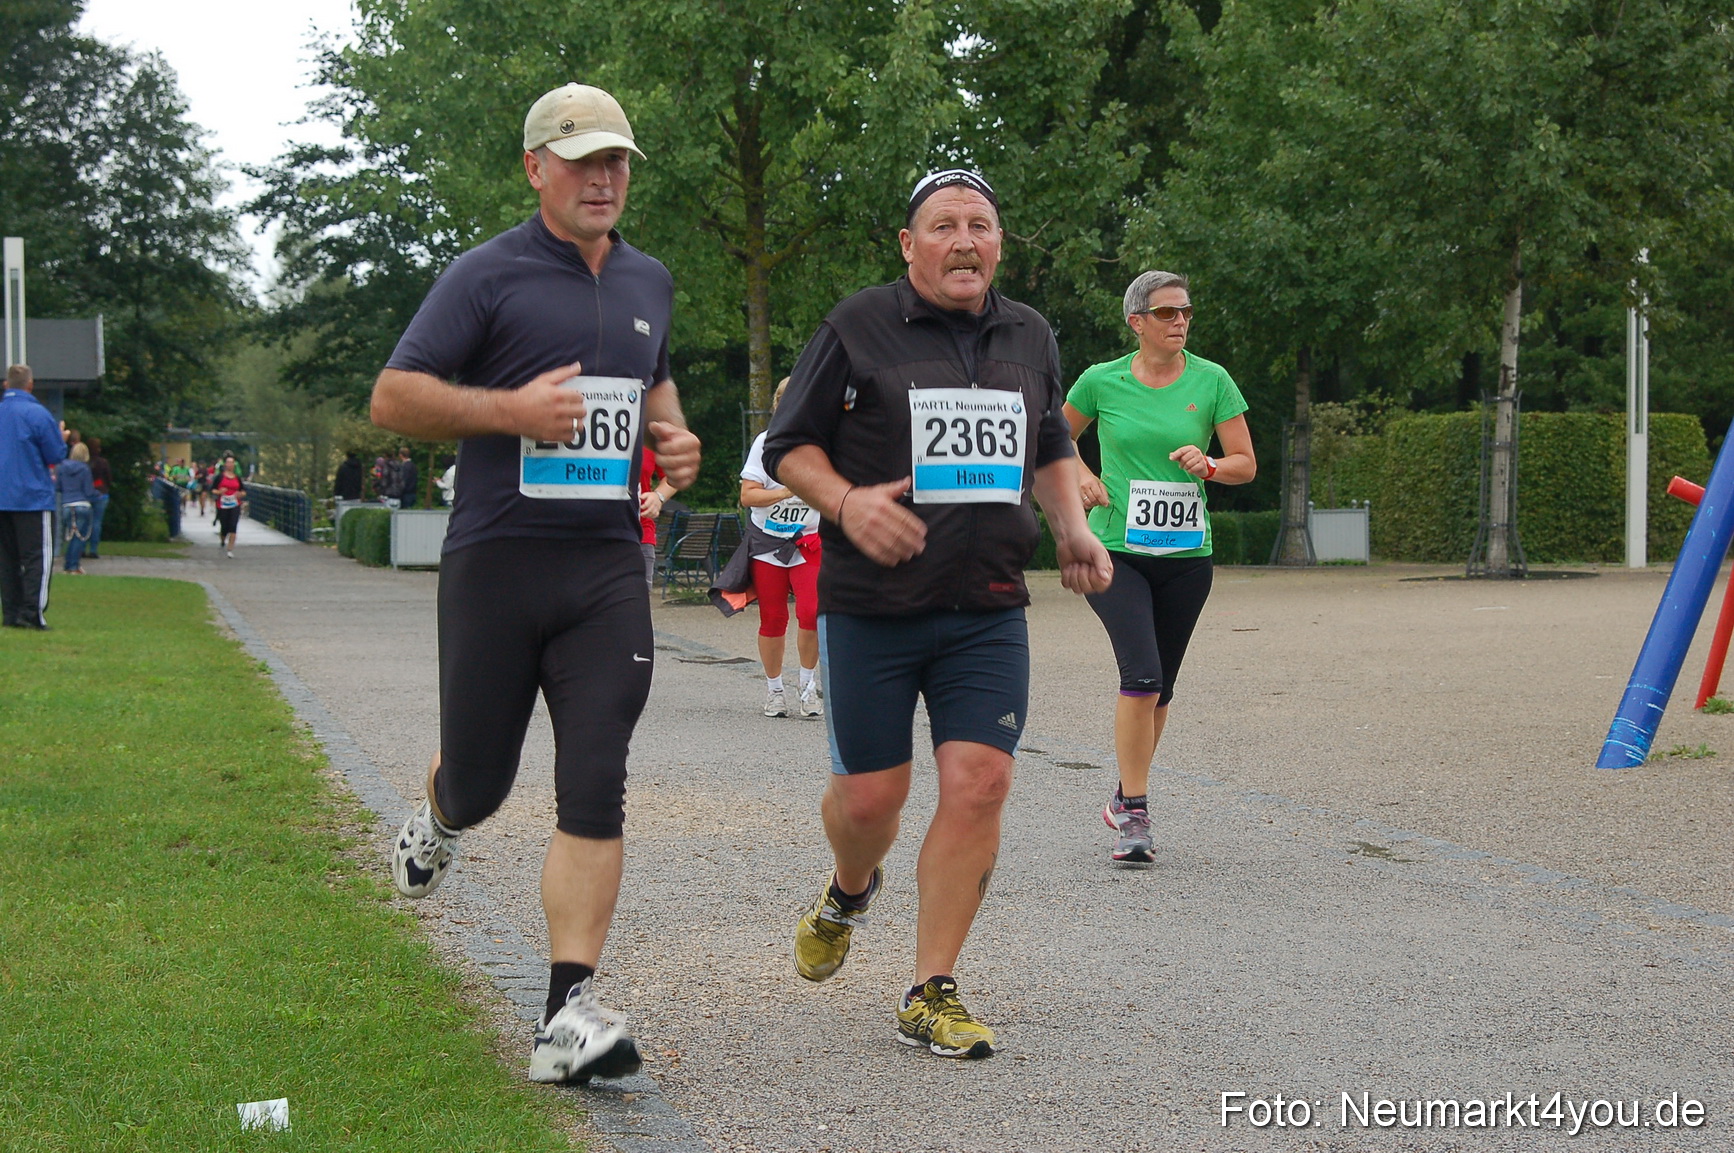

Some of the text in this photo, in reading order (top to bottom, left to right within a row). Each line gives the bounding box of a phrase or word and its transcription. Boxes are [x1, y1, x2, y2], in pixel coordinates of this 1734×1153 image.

[913, 401, 1008, 413] PARTL Neumarkt
[925, 417, 1019, 458] 2363
[565, 463, 608, 481] Peter
[956, 469, 995, 486] Hans
[1131, 487, 1195, 498] PARTL Neumarkt
[770, 505, 810, 522] 2407
[1135, 499, 1198, 527] 3094
